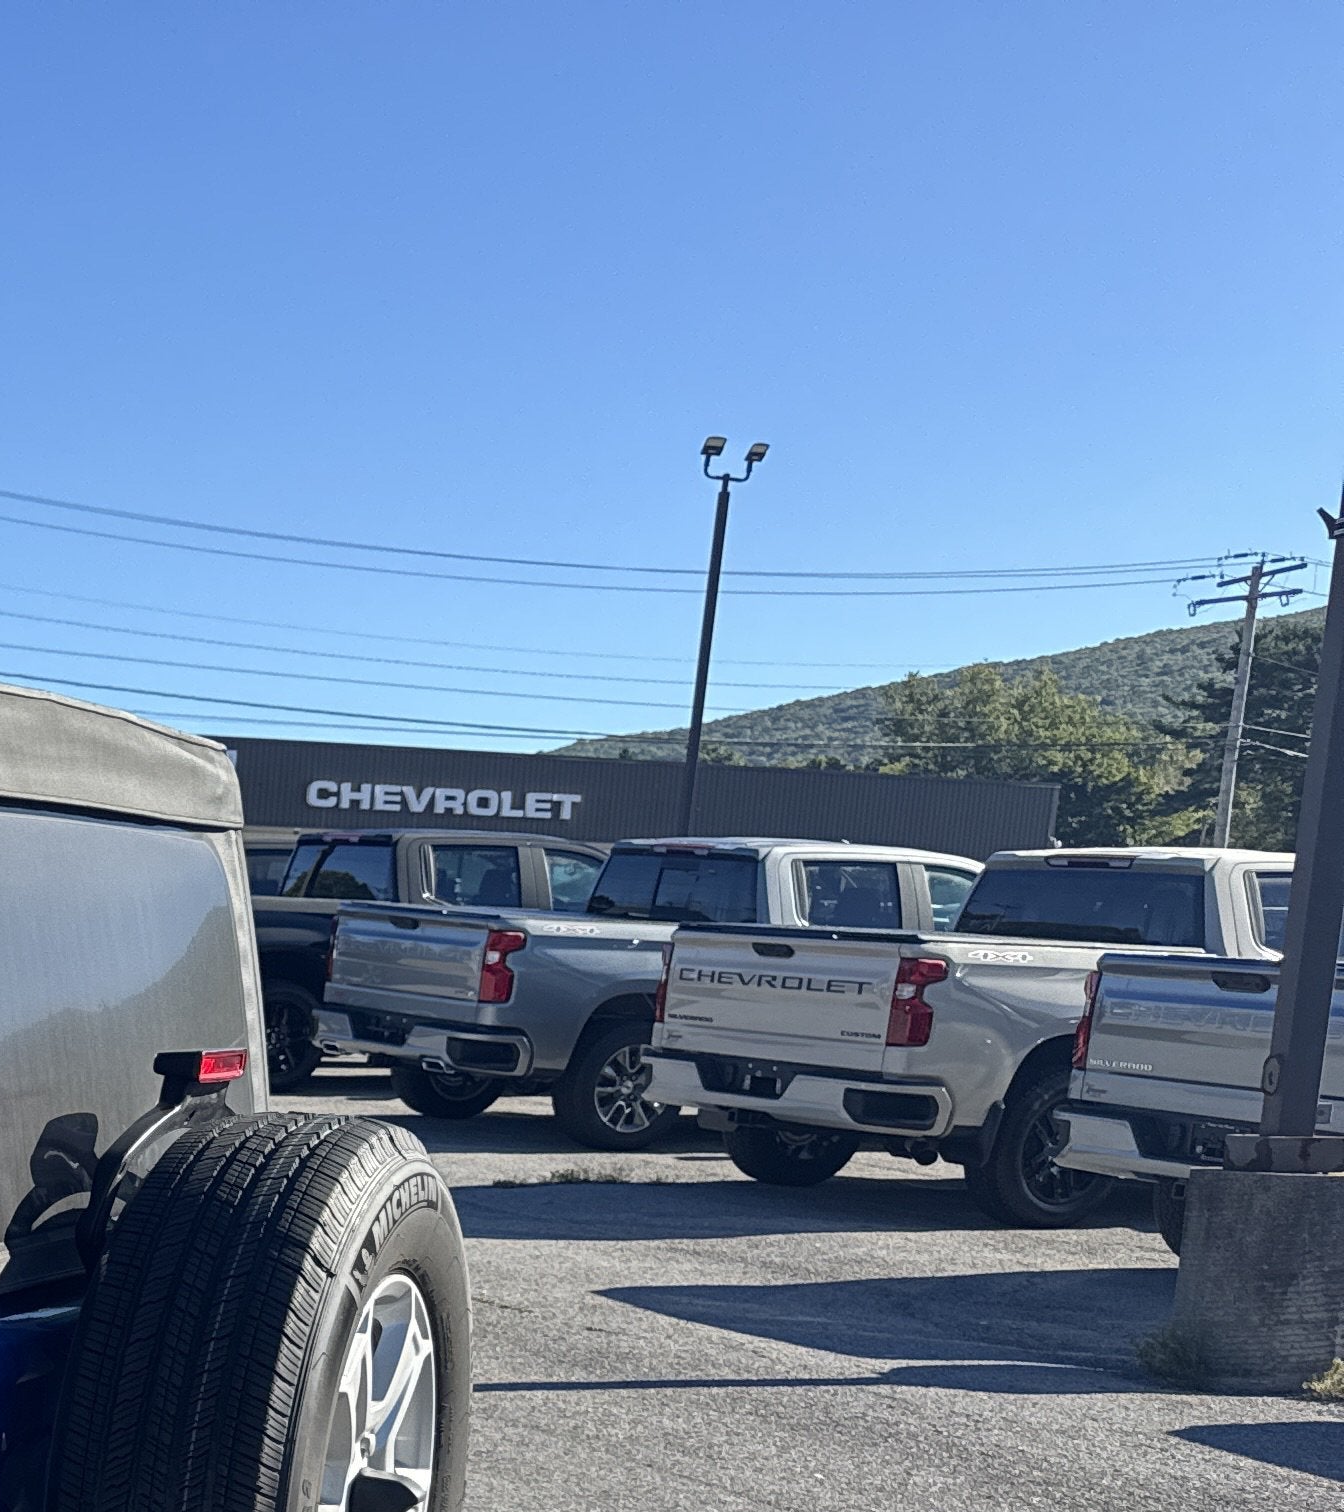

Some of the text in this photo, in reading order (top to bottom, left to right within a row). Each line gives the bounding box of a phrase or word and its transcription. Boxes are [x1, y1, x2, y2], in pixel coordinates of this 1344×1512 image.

[306, 780, 582, 820] CHEVROLET
[679, 967, 873, 995] CHEVROLET
[840, 1030, 882, 1040] CUSTOM
[371, 1174, 438, 1255] MICHELIN
